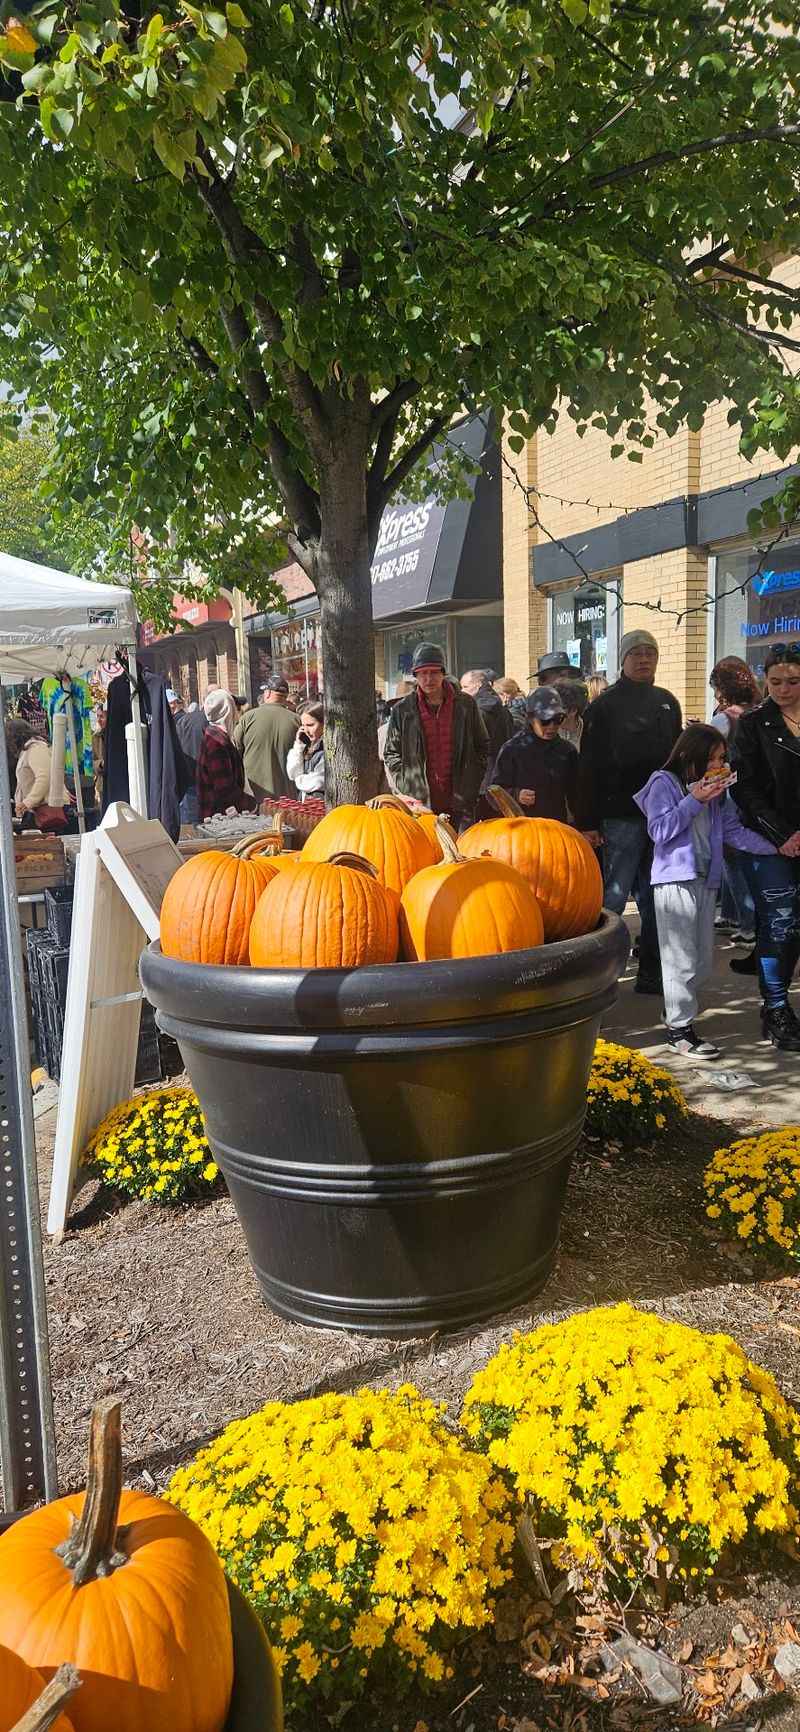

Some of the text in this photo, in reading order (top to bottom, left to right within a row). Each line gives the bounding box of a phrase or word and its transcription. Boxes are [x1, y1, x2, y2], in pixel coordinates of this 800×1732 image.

[376, 504, 432, 548] Xpress
[556, 610, 575, 625] NOW
[741, 622, 769, 636] Now
